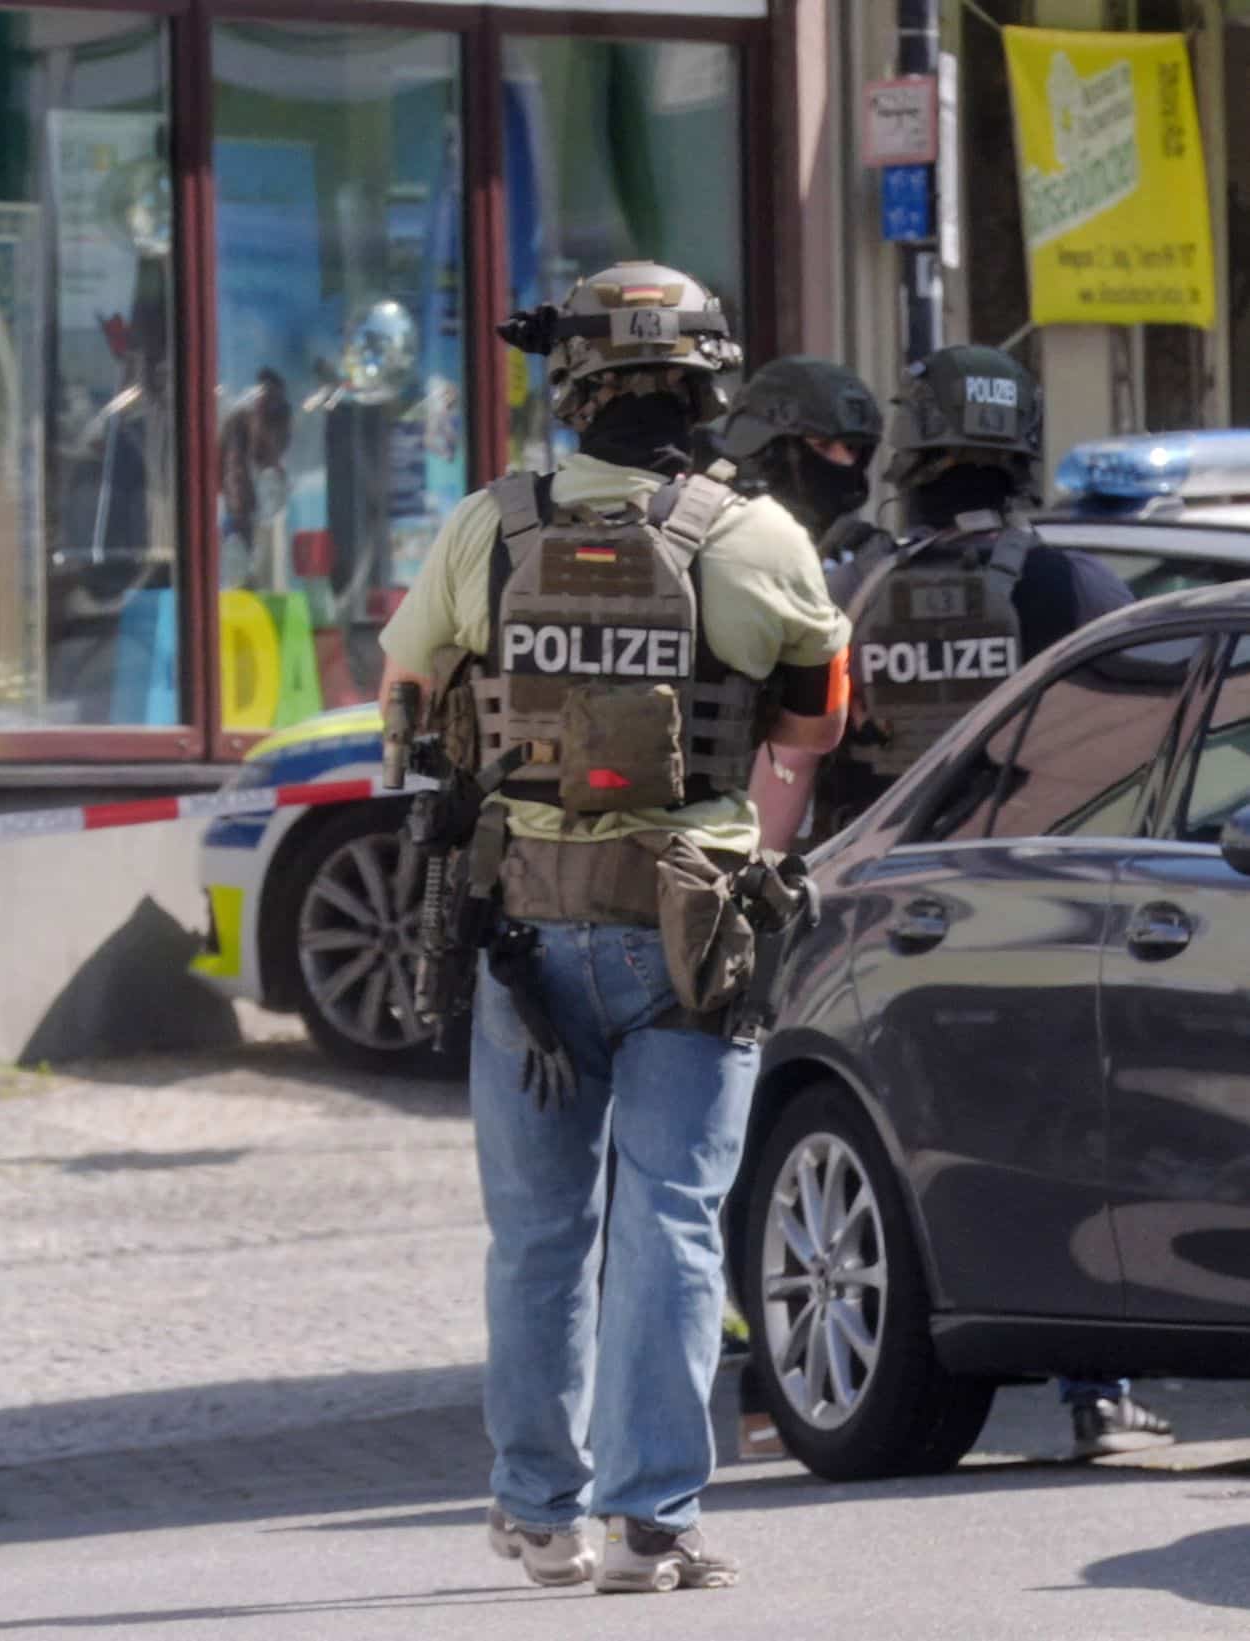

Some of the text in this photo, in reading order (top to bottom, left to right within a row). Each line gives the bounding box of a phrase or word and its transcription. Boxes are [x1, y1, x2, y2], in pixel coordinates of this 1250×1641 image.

[629, 311, 661, 337] 43
[965, 375, 1017, 407] POLIZEI
[503, 624, 691, 677] POLIZEI
[861, 636, 1017, 684] POLIZEI
